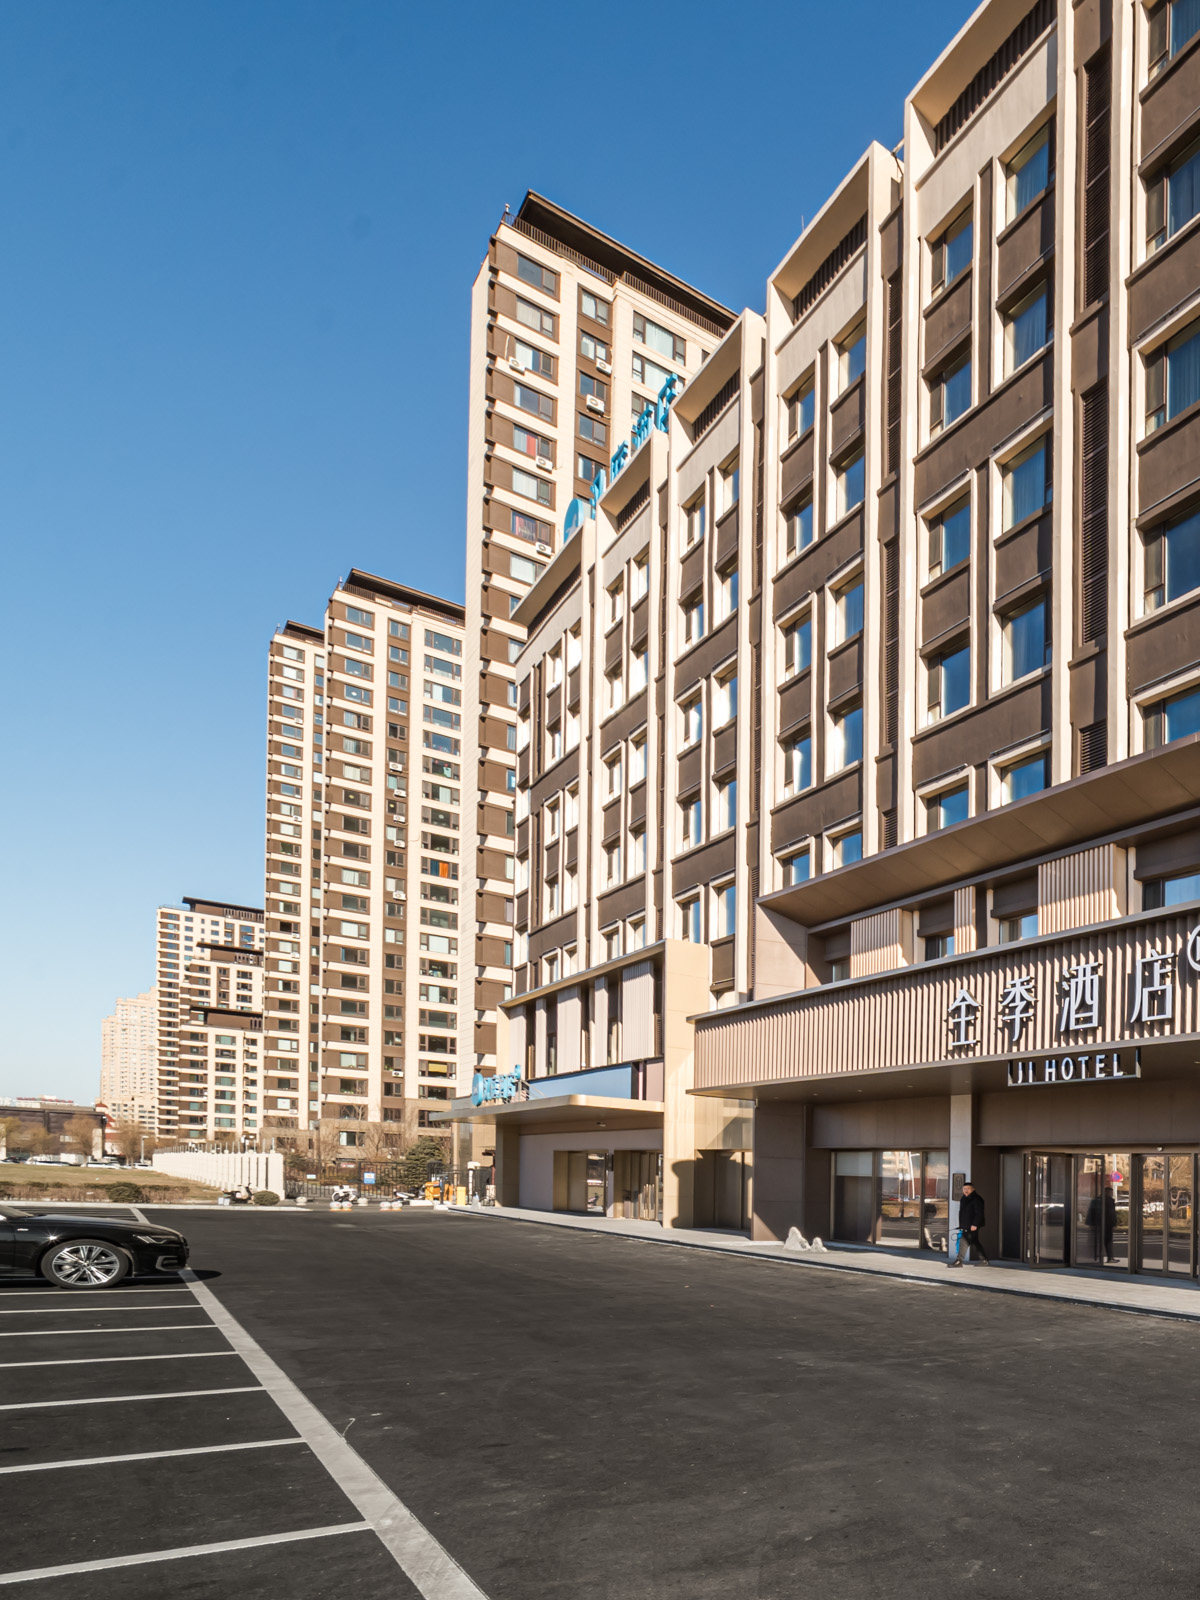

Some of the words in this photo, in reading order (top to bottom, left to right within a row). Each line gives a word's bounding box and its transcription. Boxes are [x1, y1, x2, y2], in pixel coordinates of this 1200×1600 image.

[948, 949, 1176, 1046] 全季酒店
[1017, 1061, 1033, 1084] JI
[1045, 1053, 1124, 1082] HOTEL
